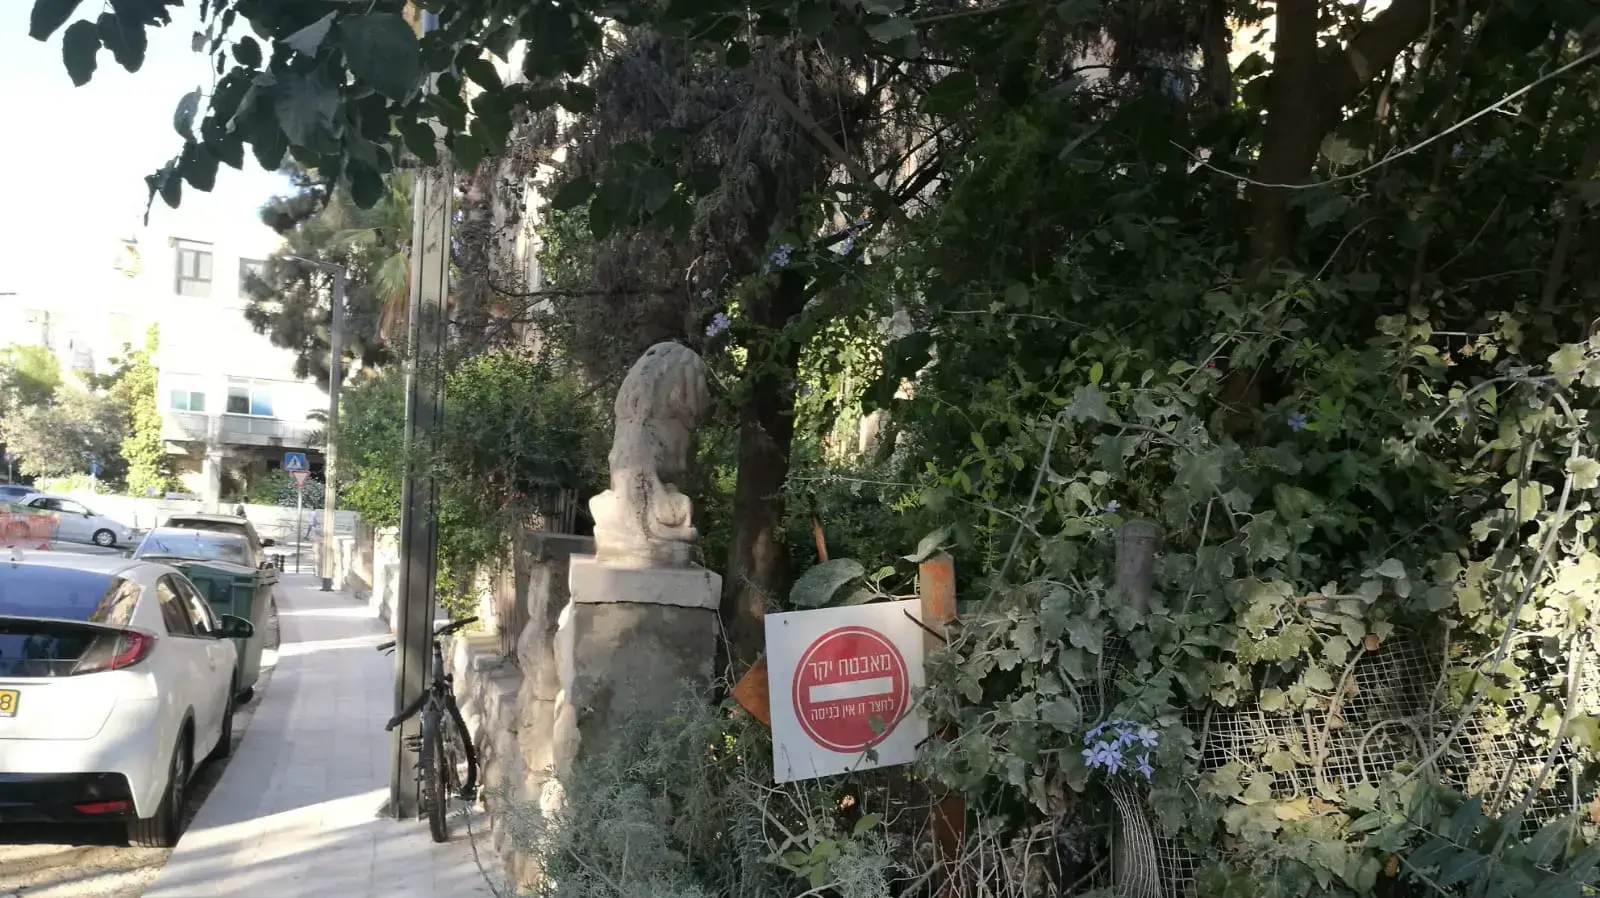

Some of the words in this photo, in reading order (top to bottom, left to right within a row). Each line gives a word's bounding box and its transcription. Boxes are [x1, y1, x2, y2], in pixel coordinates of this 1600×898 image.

[808, 660, 833, 682] יקר
[838, 653, 892, 677] מאבטח
[842, 705, 856, 719] אין
[858, 703, 866, 715] זו
[869, 698, 894, 713] לחצר
[811, 707, 840, 721] כניסה
